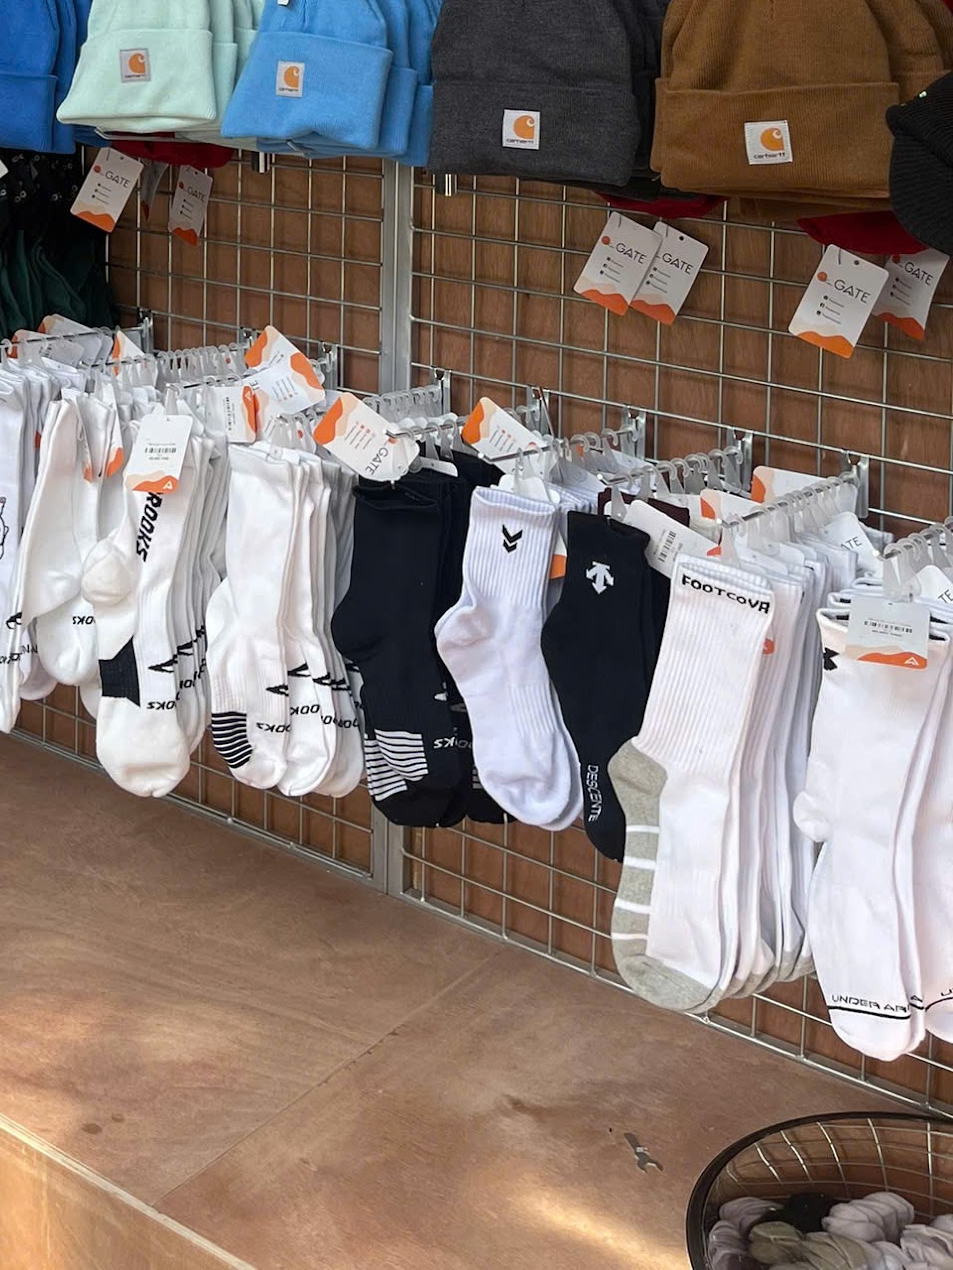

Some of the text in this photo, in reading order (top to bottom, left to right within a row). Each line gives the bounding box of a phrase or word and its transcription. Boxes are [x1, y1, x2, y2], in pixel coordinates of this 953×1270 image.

[105, 170, 131, 189] GATE
[187, 186, 206, 203] GATE
[615, 242, 647, 265] GATE
[662, 252, 694, 275] GATE
[904, 261, 934, 286] GATE
[833, 279, 871, 304] GATE
[365, 447, 389, 475] GATE
[136, 491, 163, 562] ROOKS
[681, 574, 770, 615] FOOTCOVR
[72, 615, 95, 625] OKS
[147, 700, 176, 711] OKS
[586, 764, 603, 822] DESCENTE
[831, 994, 881, 1010] UNDER
